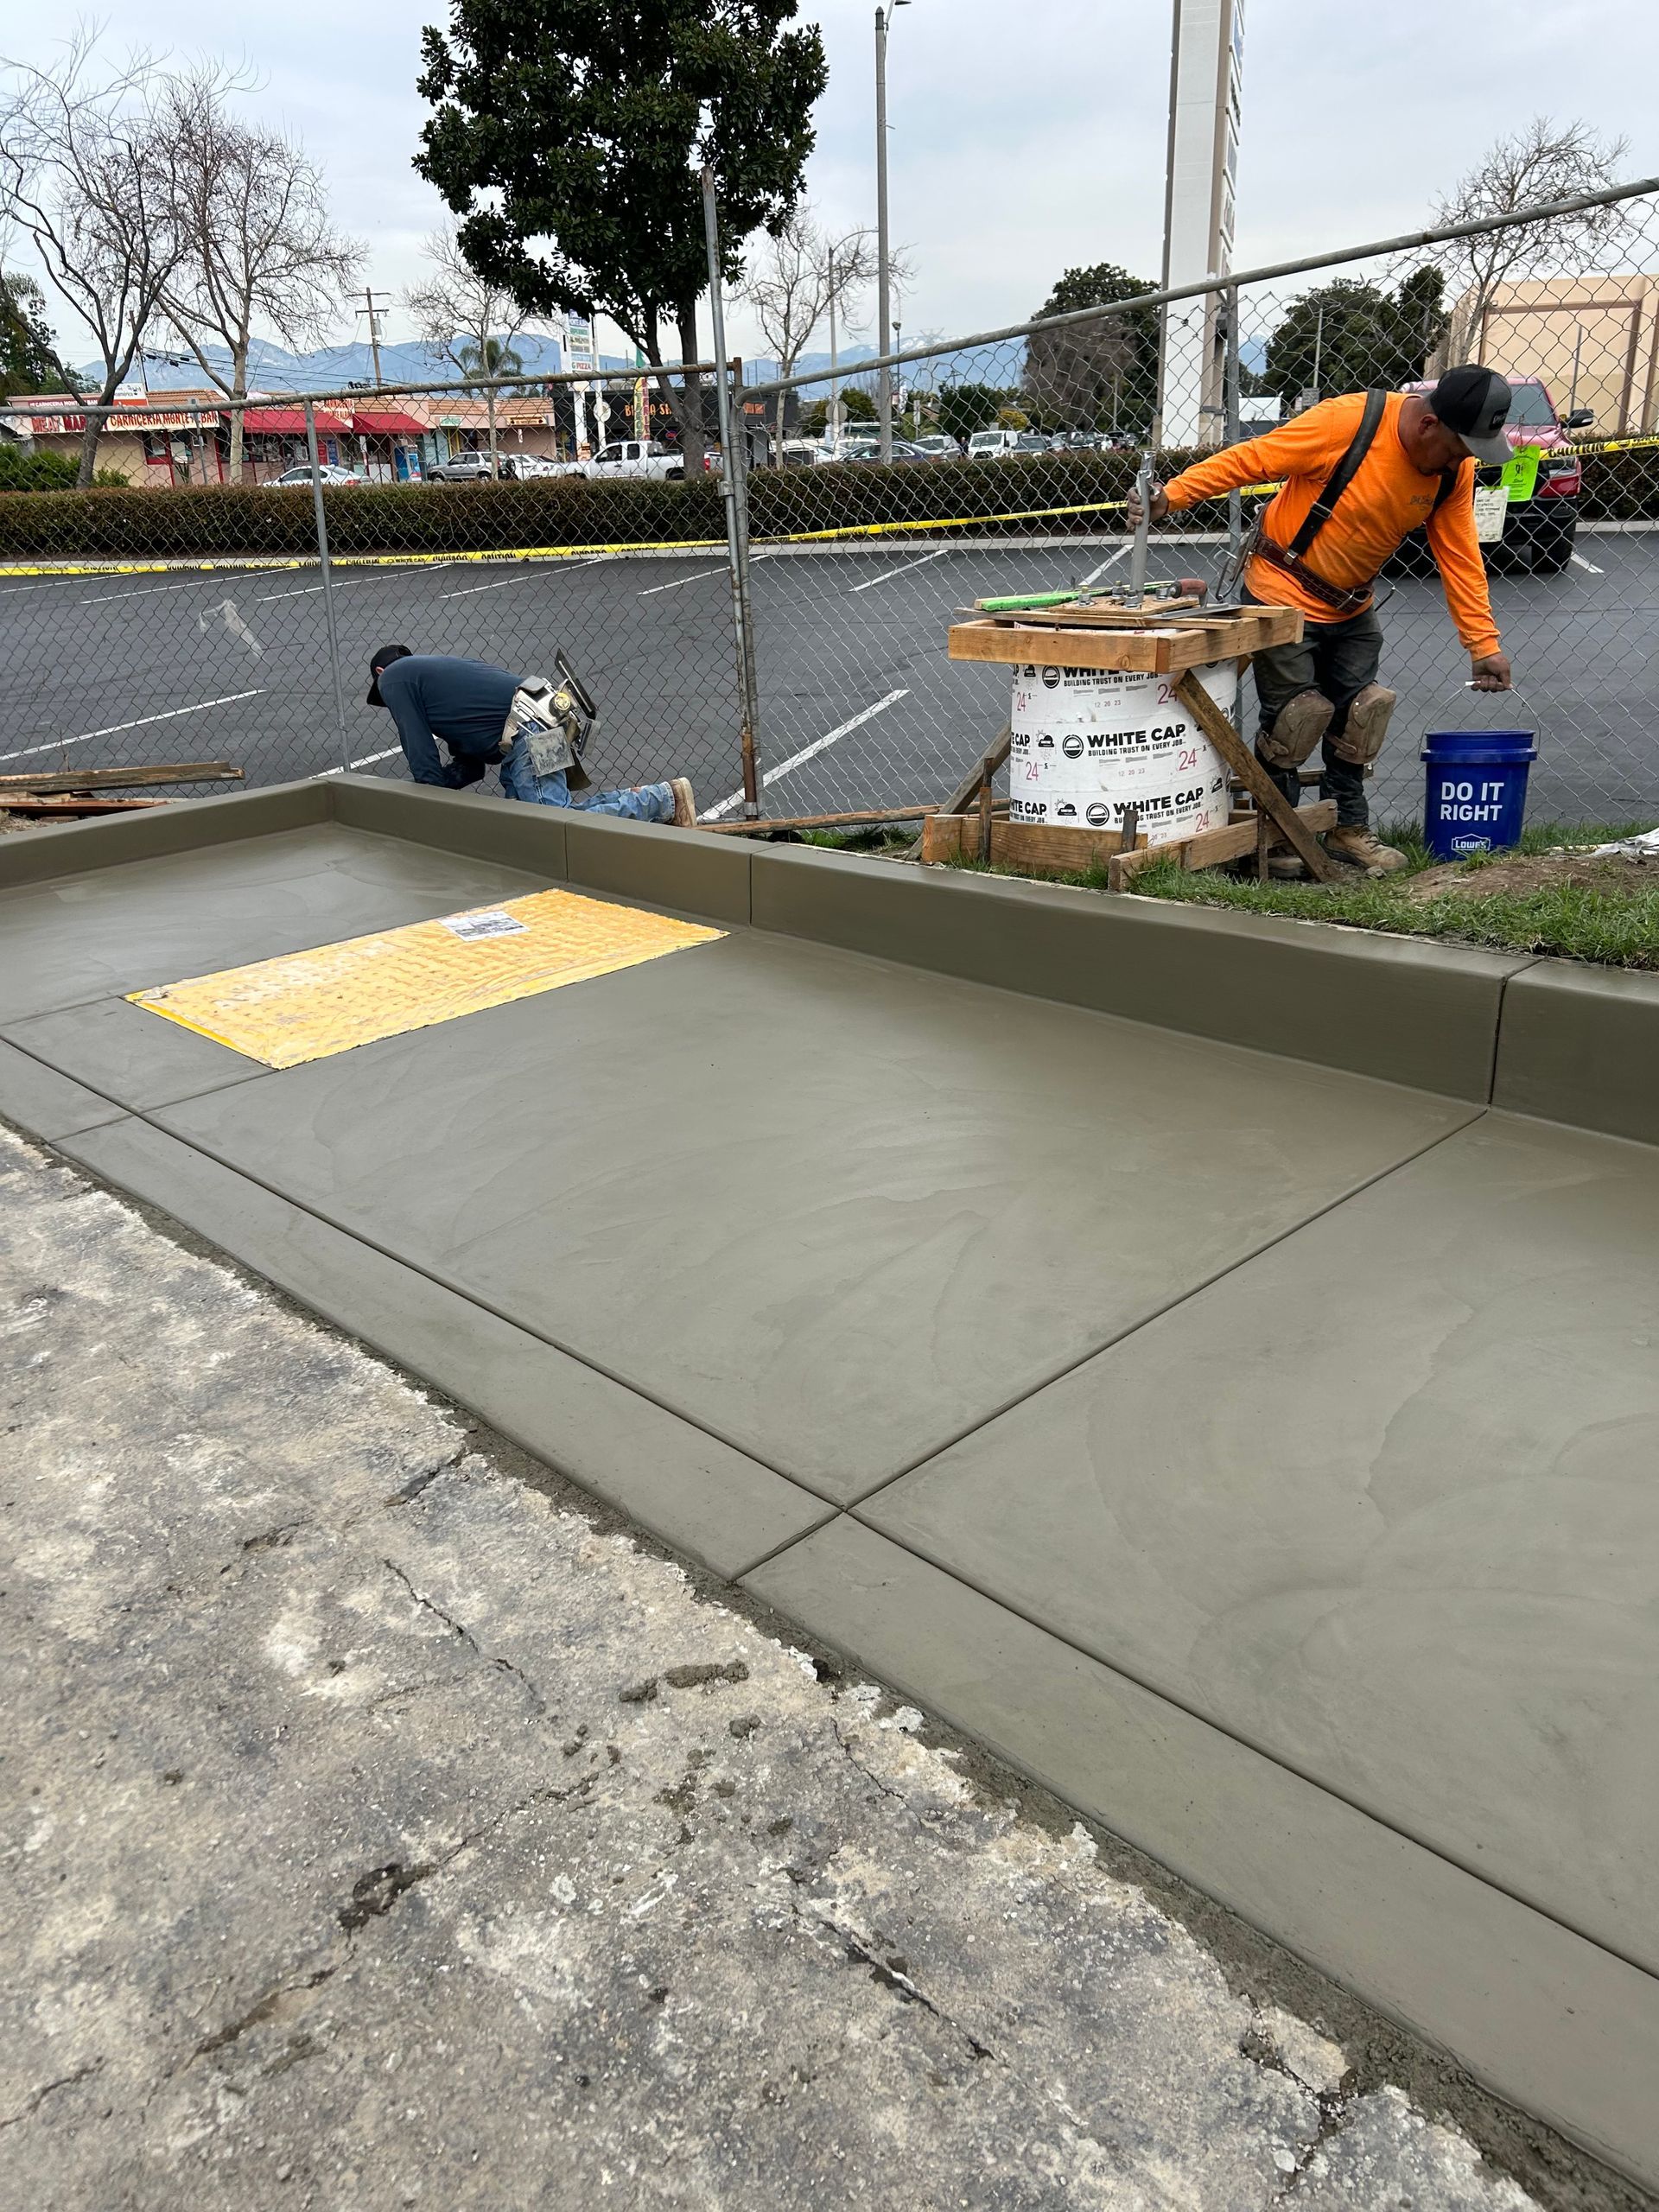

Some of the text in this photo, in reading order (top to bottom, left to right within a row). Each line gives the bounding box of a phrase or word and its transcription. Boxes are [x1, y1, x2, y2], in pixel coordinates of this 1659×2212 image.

[111, 413, 162, 427] CARNICERIA
[1017, 691, 1026, 712] 24
[1157, 683, 1178, 704] 24
[1015, 734, 1030, 747] CAP
[1087, 724, 1186, 747] WHITE CAP
[1088, 747, 1117, 757] BUILDING
[1119, 746, 1139, 754] TRUST
[1153, 741, 1170, 750] EVERY
[1179, 748, 1198, 771] 24
[1026, 761, 1039, 781] 24
[1114, 787, 1204, 815] WHITE CAP
[1441, 782, 1504, 801] DO IT
[1025, 802, 1047, 815] CAP
[1147, 811, 1164, 820] TRUST
[1440, 804, 1503, 821] RIGHT
[1196, 810, 1209, 832] 24
